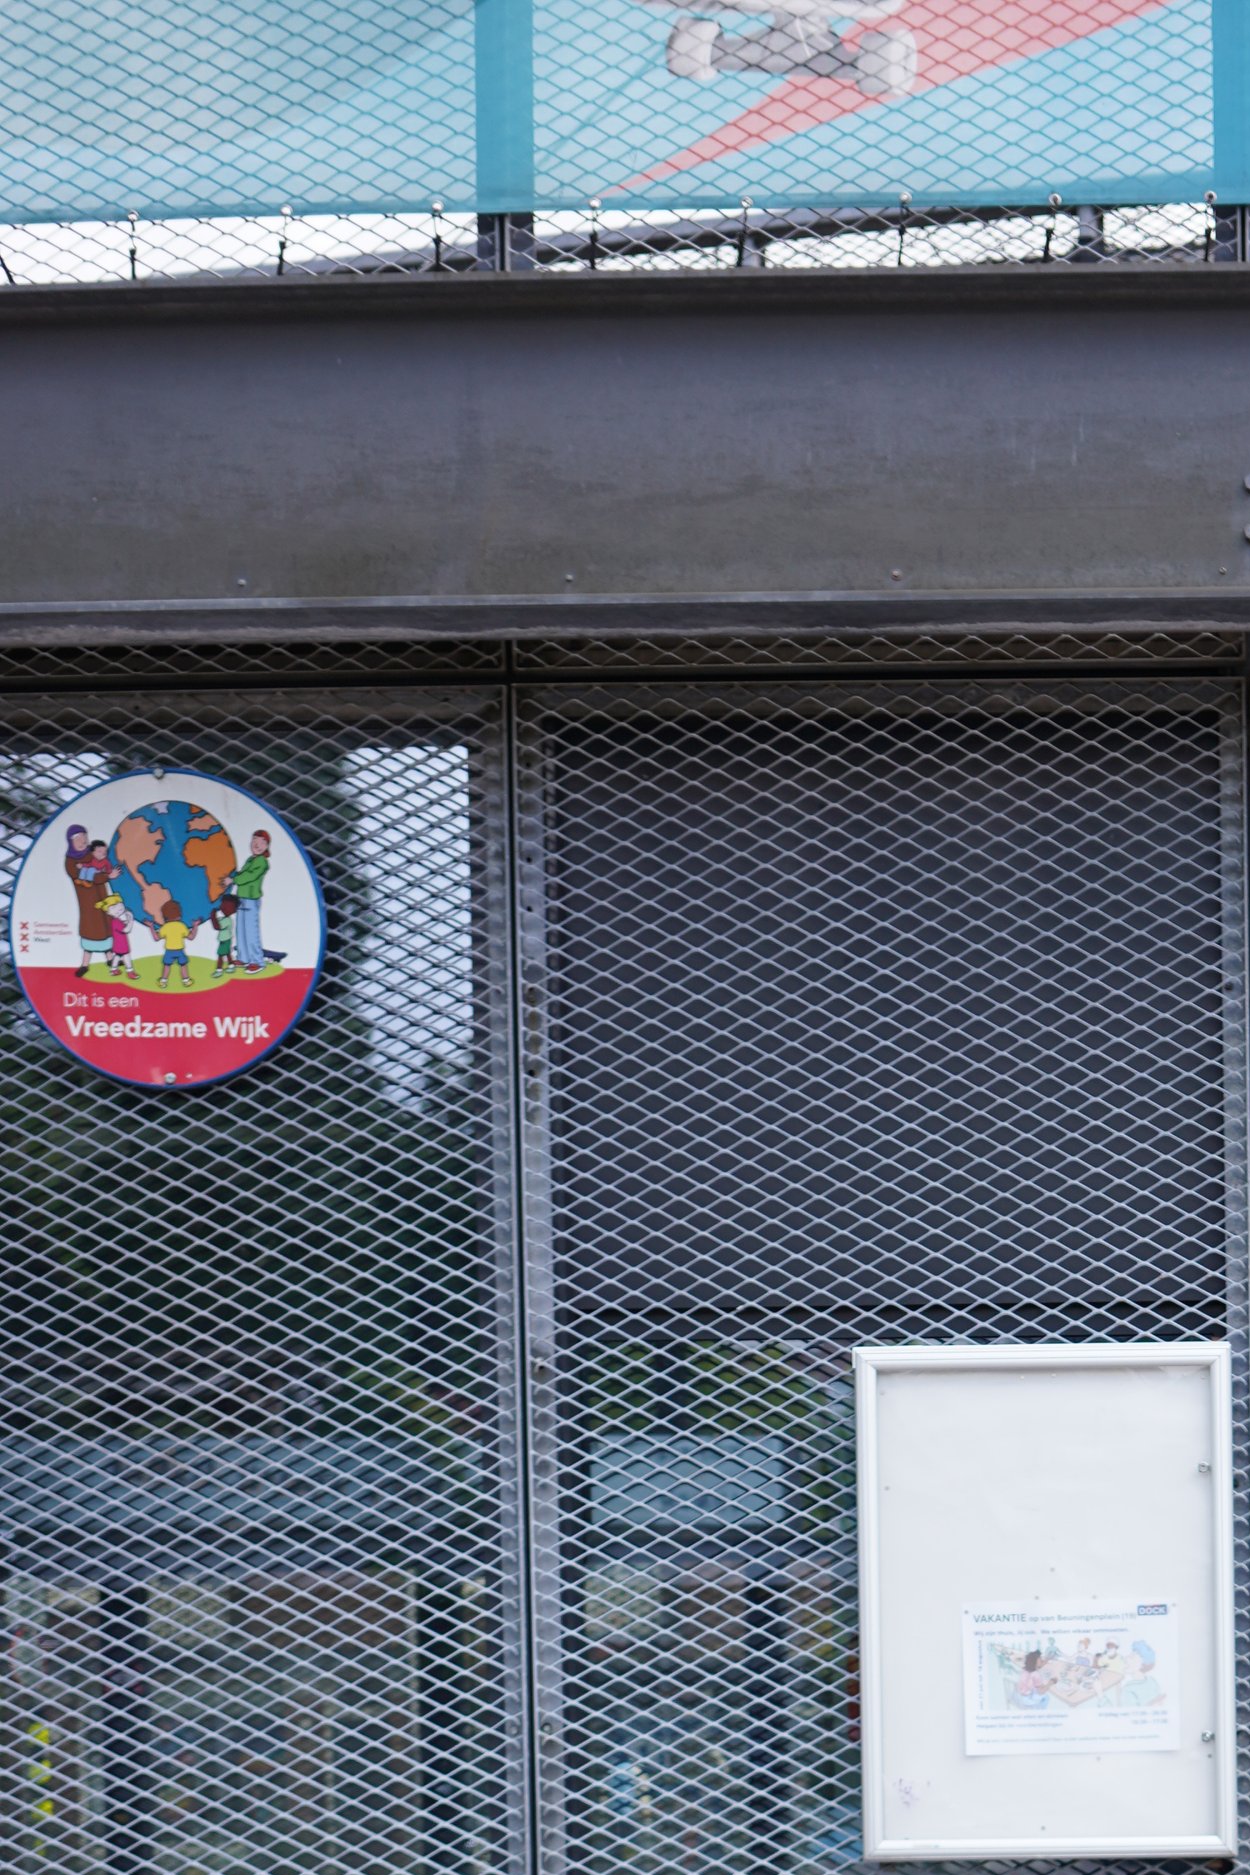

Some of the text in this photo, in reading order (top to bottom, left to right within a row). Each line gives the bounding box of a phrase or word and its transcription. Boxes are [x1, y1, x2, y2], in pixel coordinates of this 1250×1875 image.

[63, 991, 139, 1008] Dit is een
[65, 1015, 271, 1044] Vreedzame Wijk
[1139, 1606, 1167, 1615] DOCK
[973, 1614, 1026, 1623] VAKANTIE
